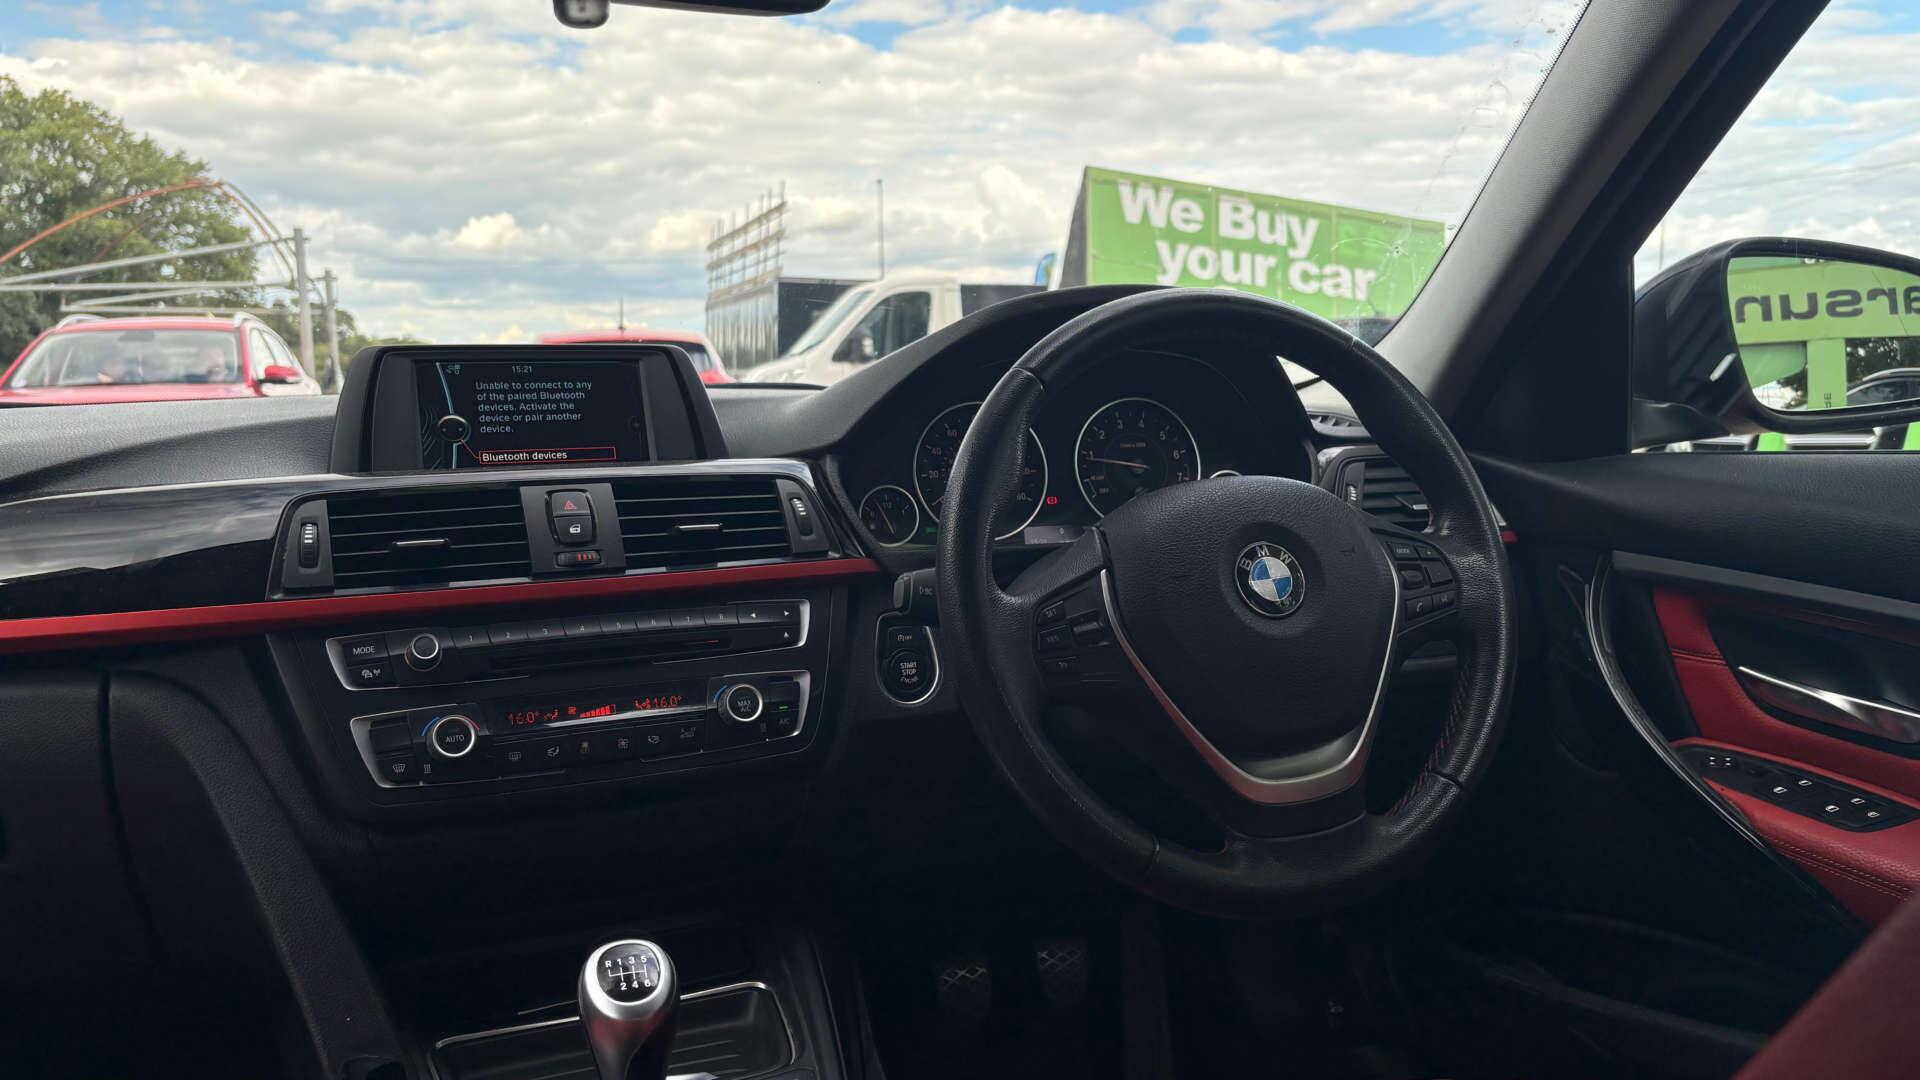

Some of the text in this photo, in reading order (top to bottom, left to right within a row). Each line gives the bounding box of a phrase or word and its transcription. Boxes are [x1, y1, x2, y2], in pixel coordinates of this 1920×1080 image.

[1118, 179, 1319, 259] We Buy
[1155, 239, 1376, 301] your car
[512, 365, 532, 374] 15:21
[476, 382, 510, 390] Unable
[576, 382, 592, 391] any
[477, 392, 585, 402] of the paired Bluetooth
[478, 404, 517, 412] devices.
[520, 403, 557, 411] Activate
[480, 414, 510, 422] device
[526, 413, 543, 422] pair
[546, 412, 581, 421] another
[1117, 419, 1123, 429] 3
[1138, 419, 1145, 428] 4
[480, 425, 514, 433] device.
[1099, 431, 1105, 439] 2
[1160, 431, 1166, 440] 5
[482, 451, 568, 461] Bluetooth devices
[1174, 450, 1180, 459] 6
[1177, 472, 1182, 481] 7
[1239, 545, 1292, 571] BMW
[352, 646, 375, 656] MODE
[445, 734, 465, 744] AUTO
[620, 982, 627, 990] 2
